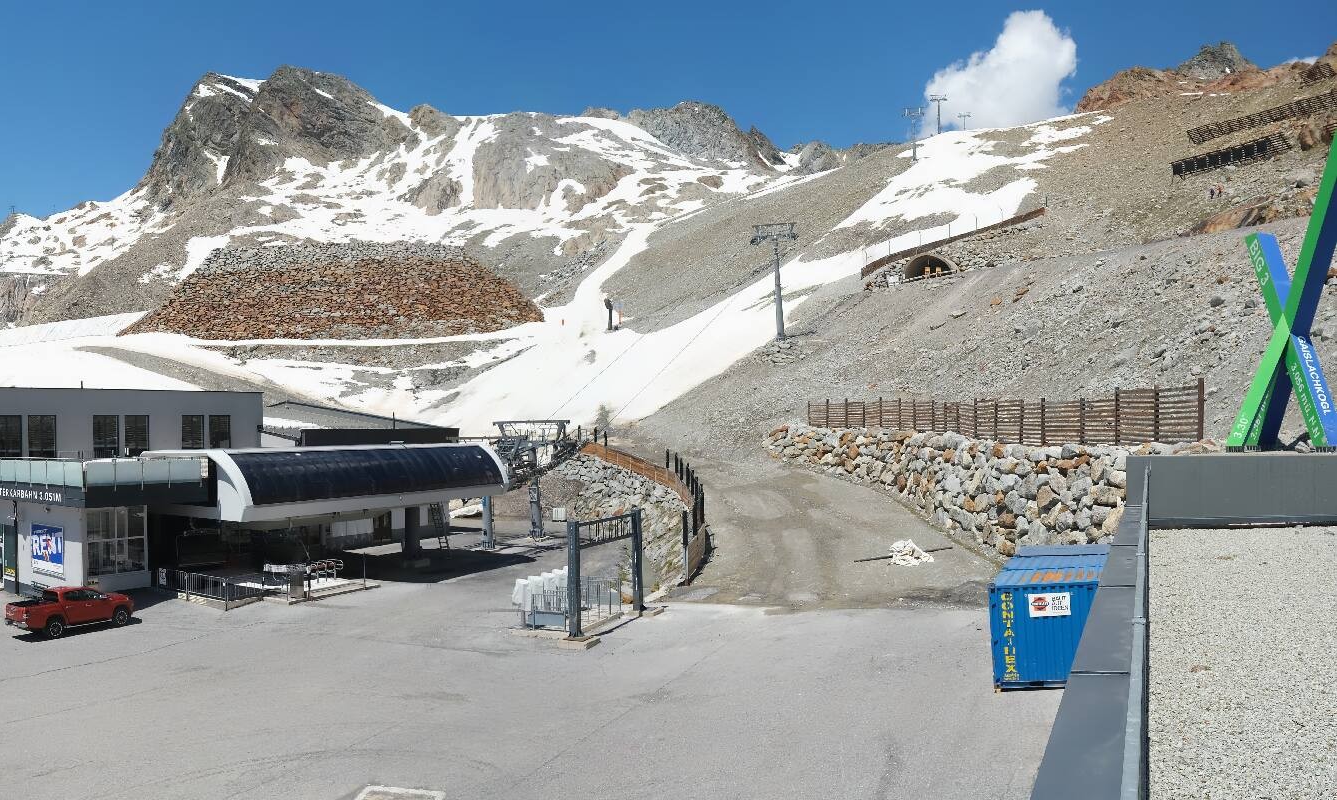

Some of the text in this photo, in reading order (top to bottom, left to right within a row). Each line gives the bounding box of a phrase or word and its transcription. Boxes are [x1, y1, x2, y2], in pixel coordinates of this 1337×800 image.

[1249, 239, 1270, 286] BIG 3
[1298, 336, 1331, 416] GAISLACHKOGL
[1233, 415, 1249, 439] 3.30
